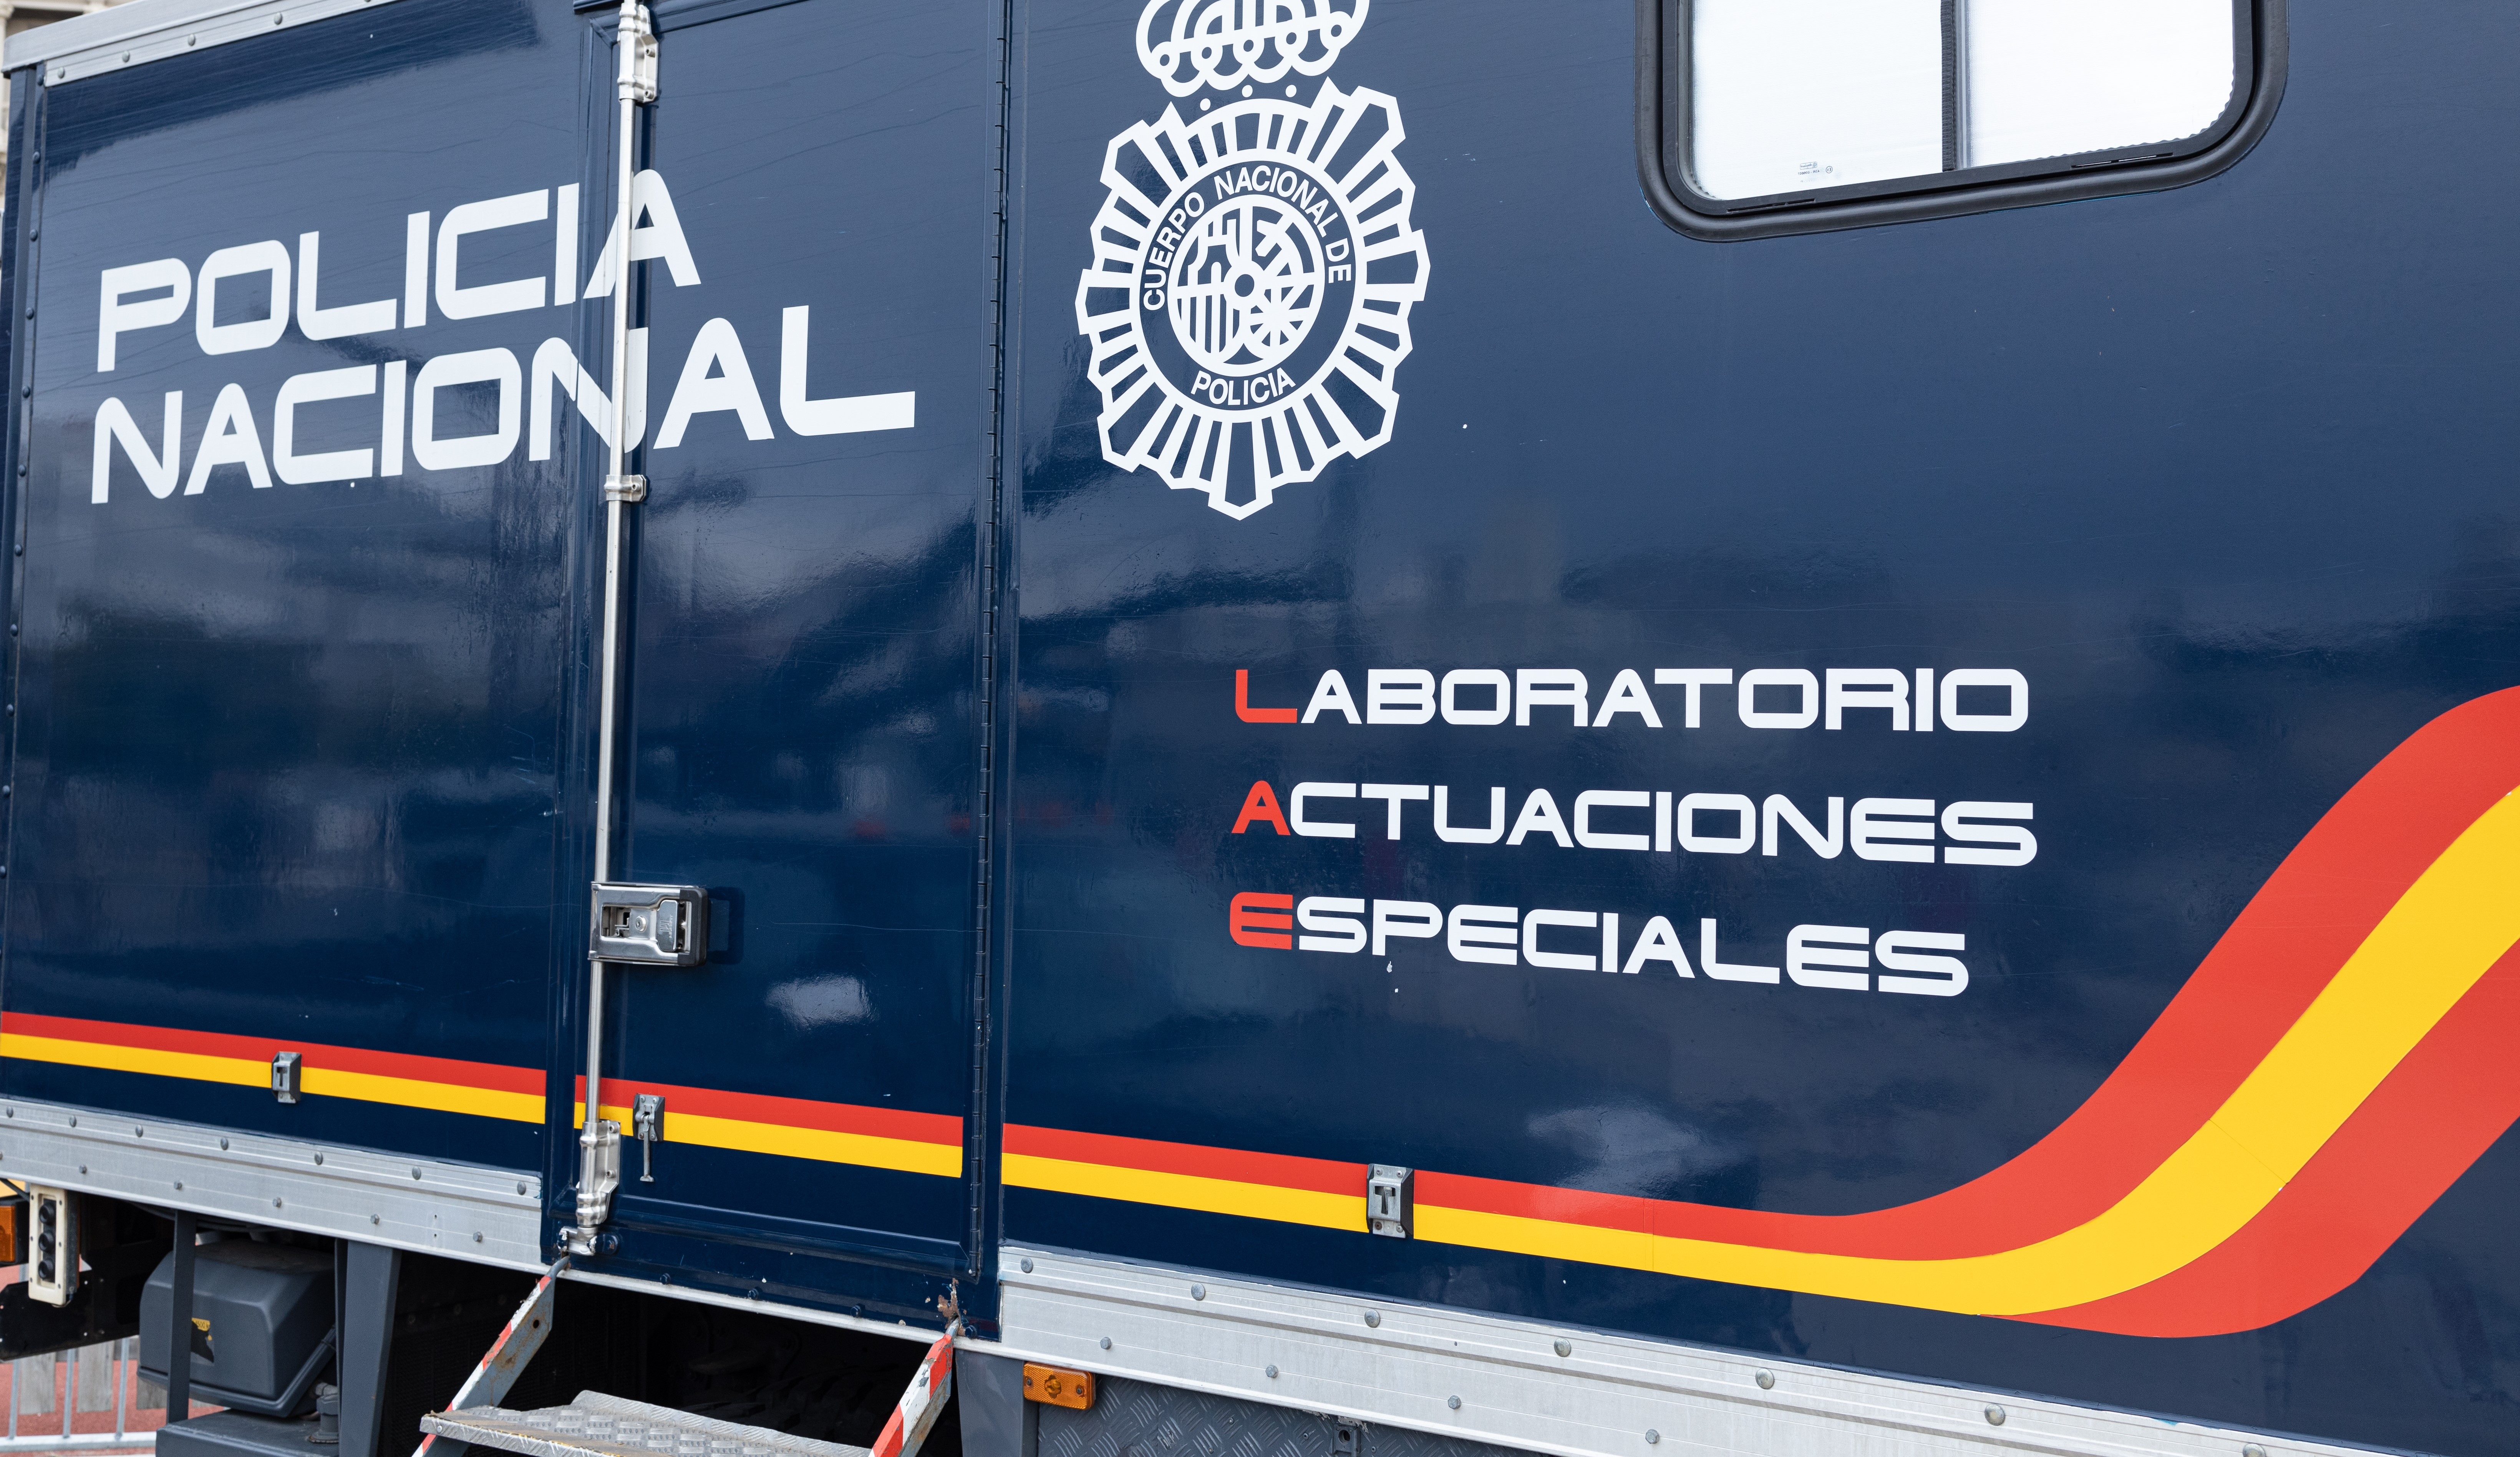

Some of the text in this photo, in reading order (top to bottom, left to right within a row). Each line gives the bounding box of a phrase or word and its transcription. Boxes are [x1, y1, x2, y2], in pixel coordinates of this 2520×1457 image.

[97, 170, 701, 372] POLICIA
[1143, 165, 1351, 310] CUERPO NACIONAL DE
[91, 305, 915, 504] NACIONAL
[1190, 367, 1296, 405] POLICIA
[1235, 668, 2029, 732] LABORATORIO
[1231, 780, 2037, 867] ACTUACIONES
[1229, 892, 1969, 997] ESPECIALES
